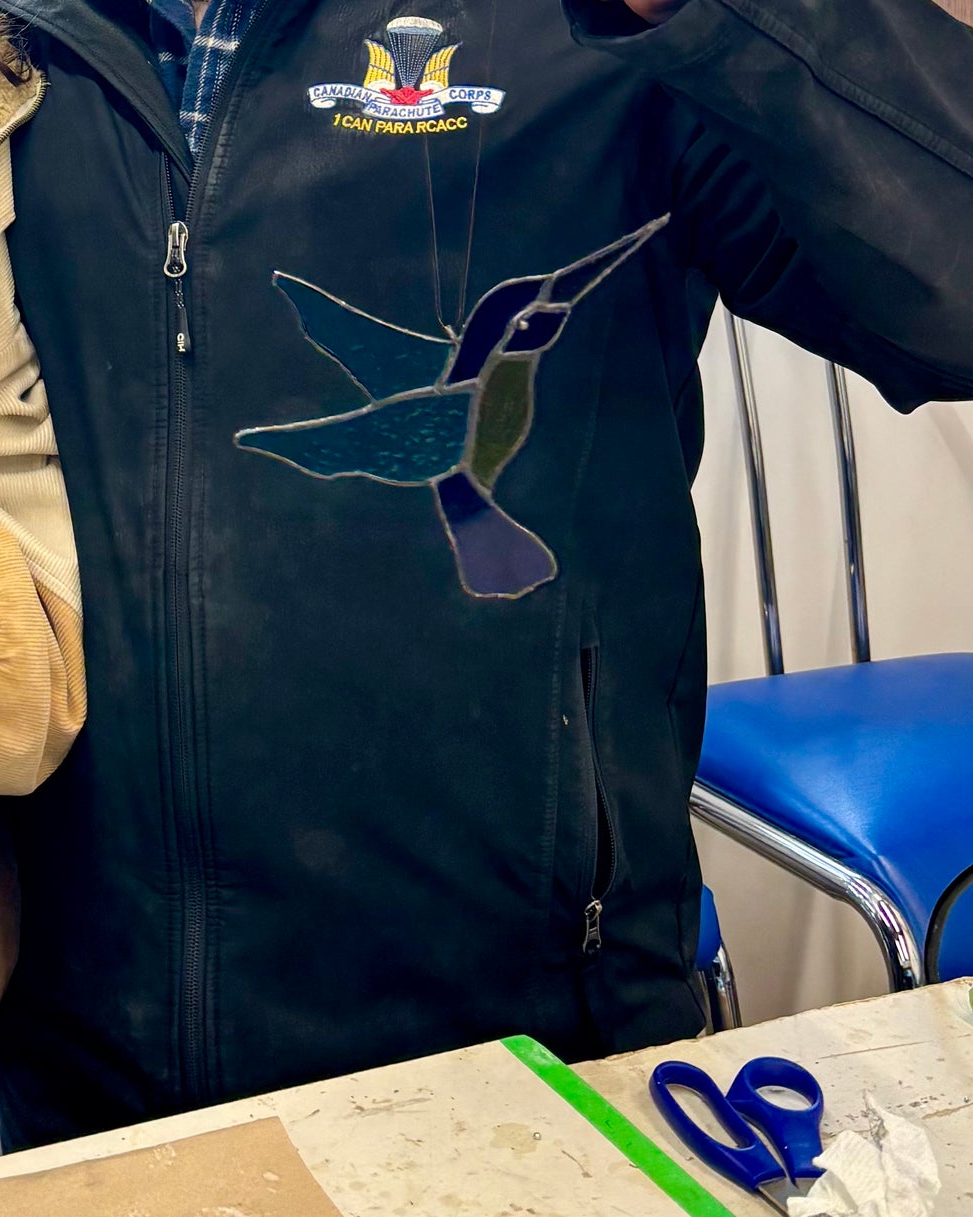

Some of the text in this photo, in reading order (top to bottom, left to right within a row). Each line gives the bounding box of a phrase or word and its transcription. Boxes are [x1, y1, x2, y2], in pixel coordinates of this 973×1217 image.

[313, 85, 492, 118] CANADIAN PARACHUTE CORPS
[333, 113, 468, 134] 1 CAN PARA RCACC
